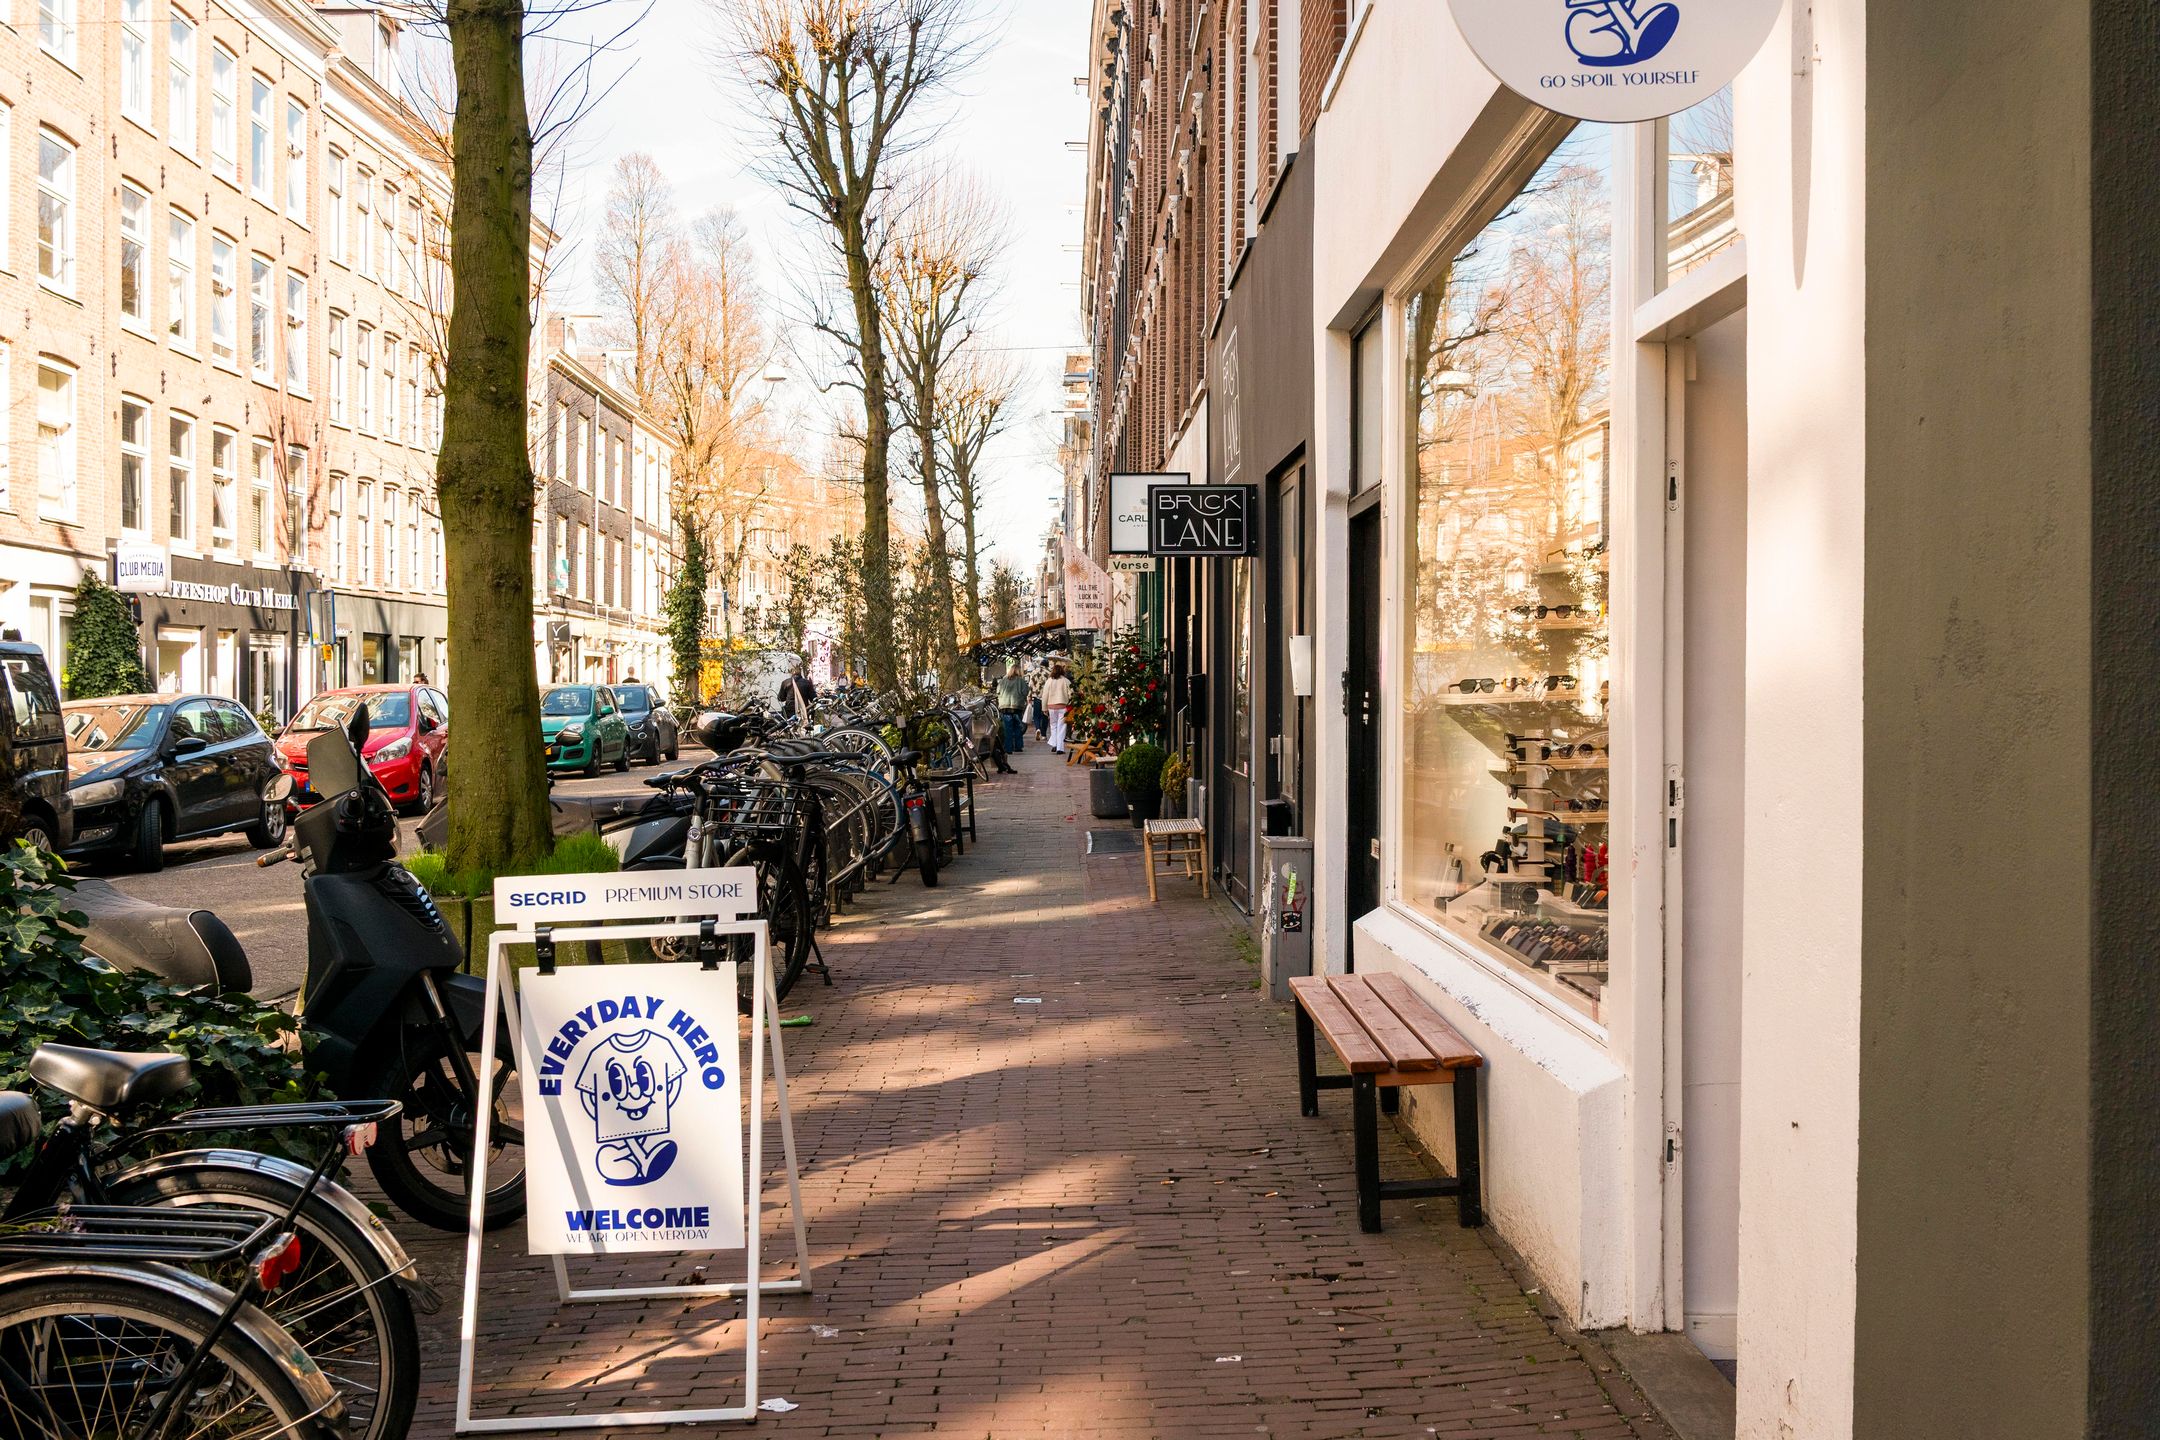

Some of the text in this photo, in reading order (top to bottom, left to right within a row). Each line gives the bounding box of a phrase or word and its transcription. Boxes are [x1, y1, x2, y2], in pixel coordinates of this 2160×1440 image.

[1540, 70, 1700, 88] GO SPOIL YOURSELF
[1159, 494, 1241, 516] BRICK
[1118, 514, 1148, 522] CARL
[1160, 518, 1241, 547] LANE
[119, 561, 164, 577] CLUB MEDIA
[1113, 561, 1149, 570] Verse
[510, 883, 743, 907] SECRID PREMIUM STORE
[539, 996, 725, 1095] EVERYDAY HERO
[565, 1206, 710, 1231] WELCOME
[567, 1229, 710, 1243] WE ARE OPEN EVERYDAY
